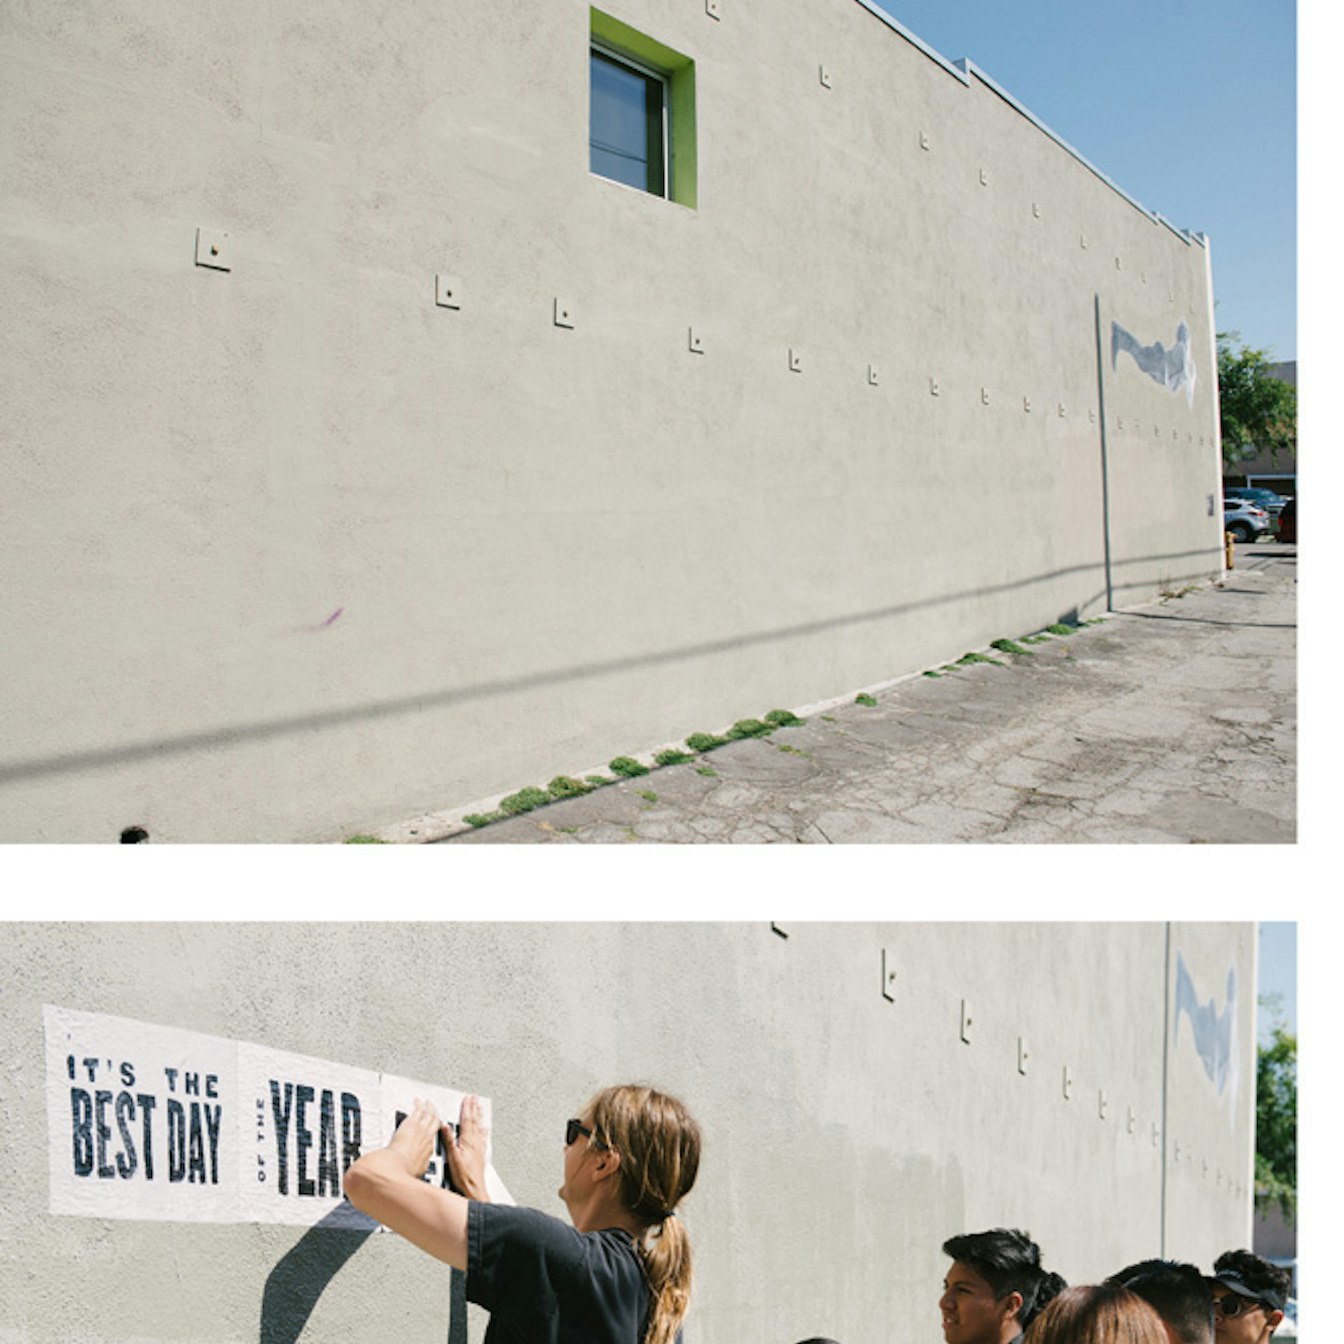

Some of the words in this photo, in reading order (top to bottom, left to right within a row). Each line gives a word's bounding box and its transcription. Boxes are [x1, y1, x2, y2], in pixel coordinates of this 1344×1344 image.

[66, 1055, 136, 1087] IT'S
[165, 1067, 219, 1098] THE
[70, 1087, 156, 1180] BEST
[168, 1100, 222, 1184] DAY
